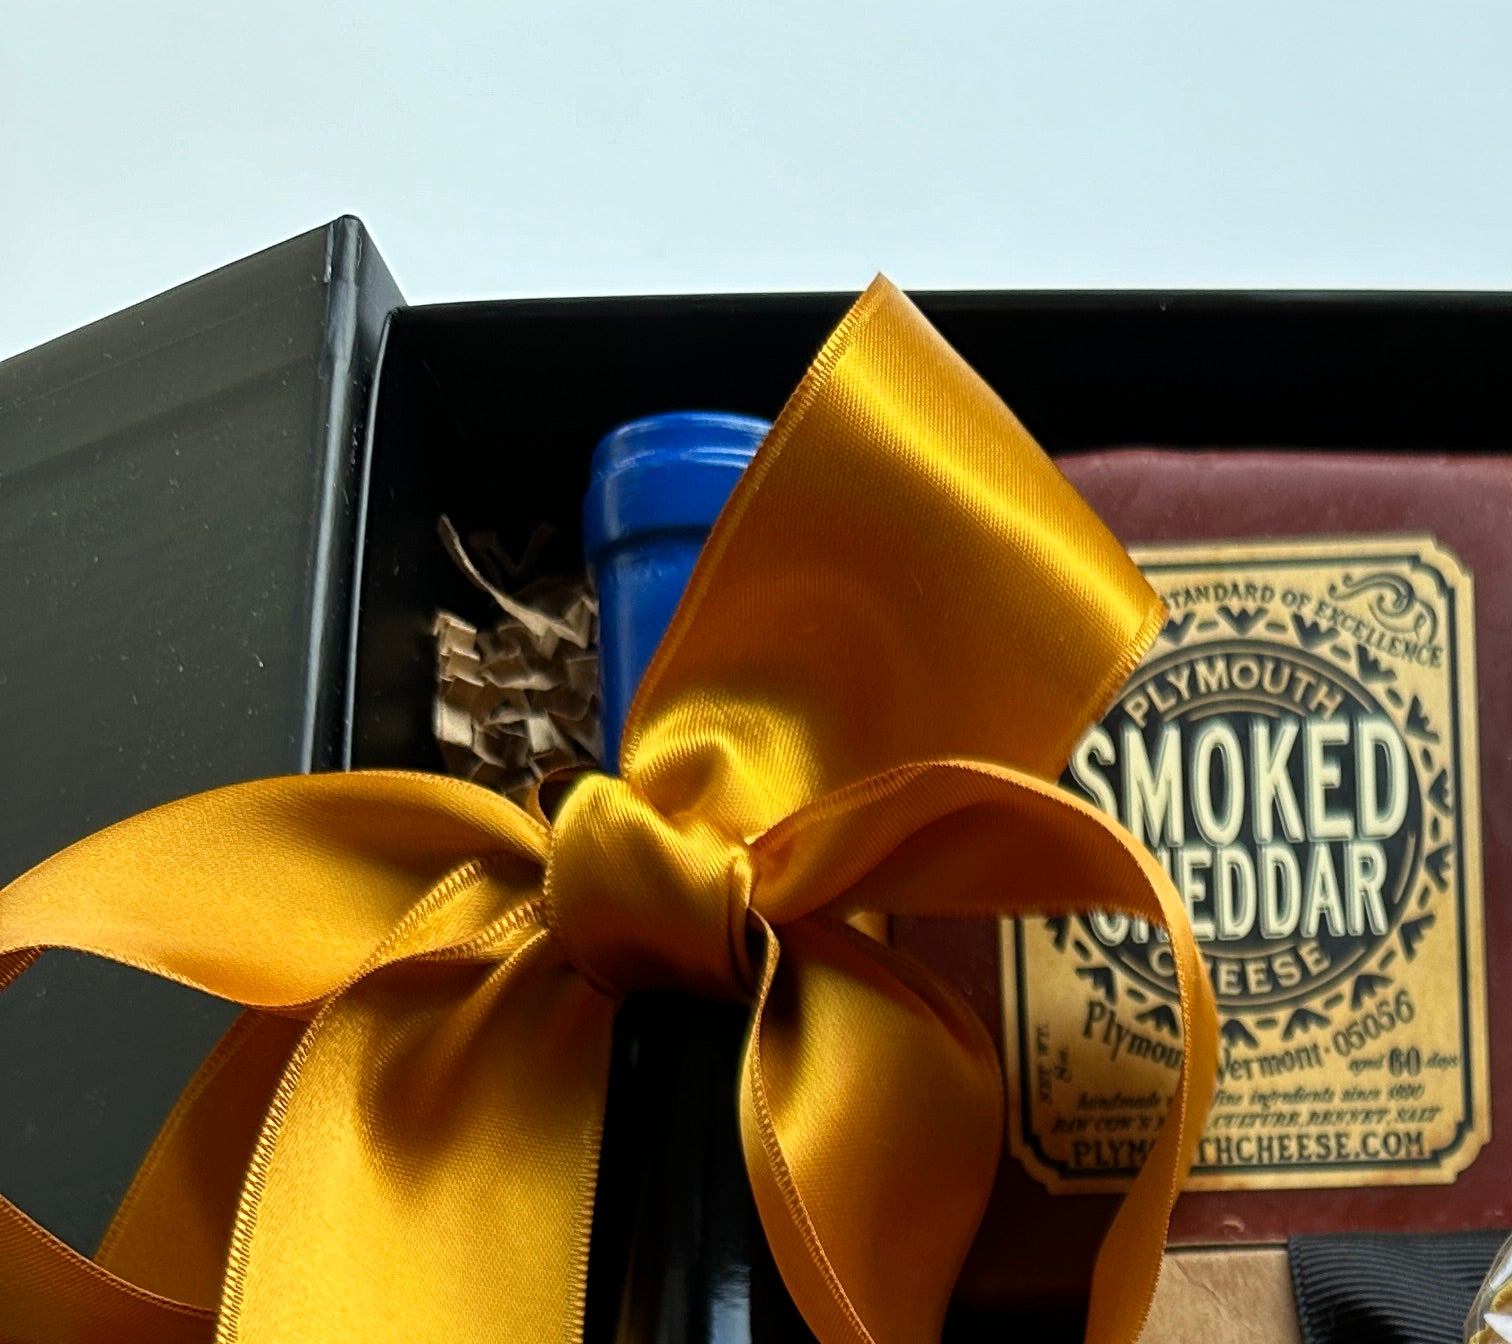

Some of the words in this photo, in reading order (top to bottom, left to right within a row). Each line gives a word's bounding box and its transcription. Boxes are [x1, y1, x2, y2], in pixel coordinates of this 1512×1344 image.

[1281, 587, 1312, 612] OF
[1314, 601, 1443, 669] EXCELLENCE
[1123, 657, 1344, 729] PLYMOUTH
[1068, 712, 1410, 849] SMOKED
[1148, 940, 1332, 997] CEESE
[1083, 1000, 1184, 1070] Plymou
[1332, 989, 1416, 1057] 05056
[1073, 1131, 1425, 1168] PLYMTHCHEESE.COM
